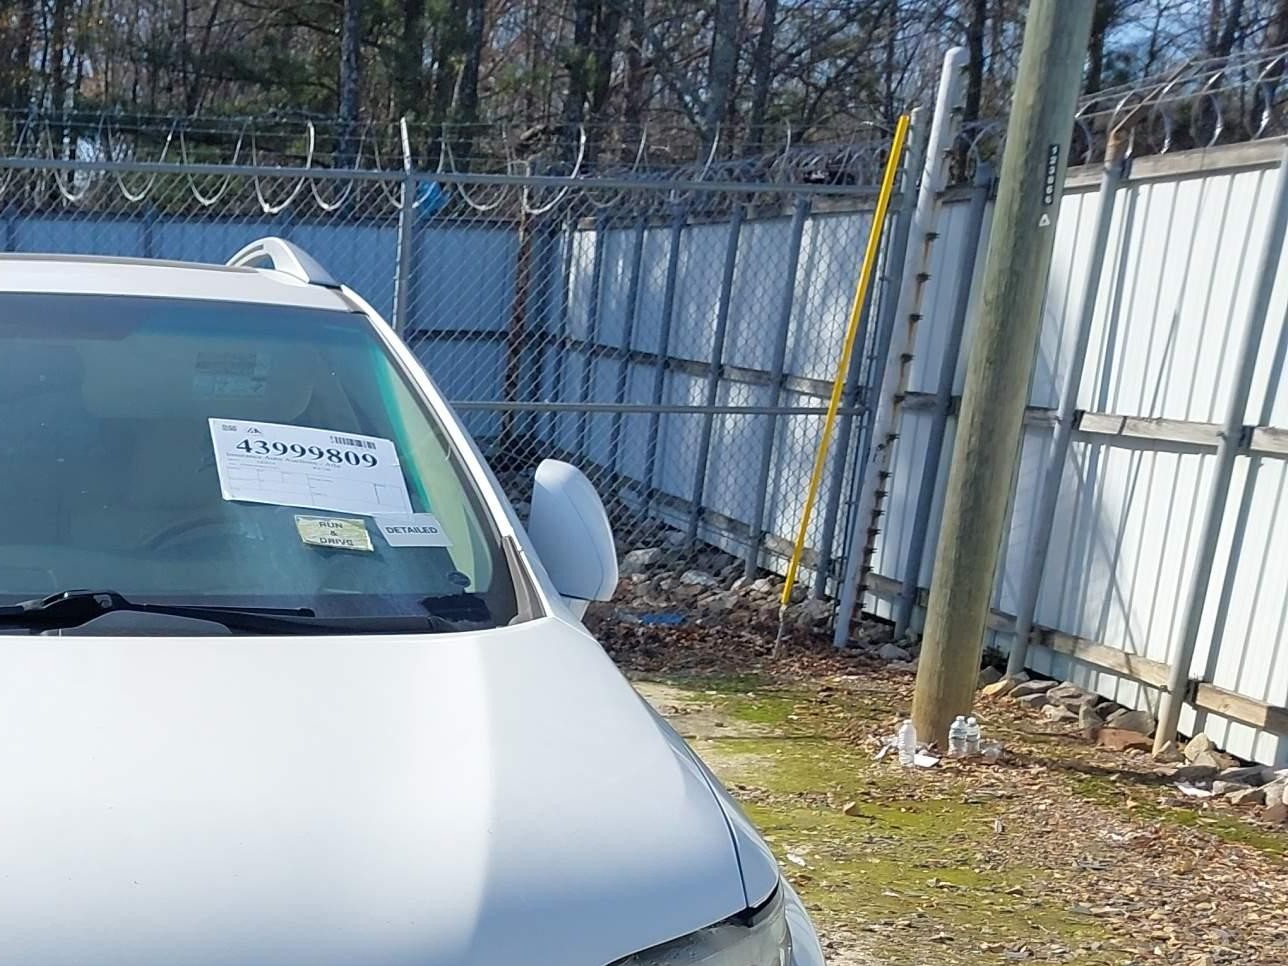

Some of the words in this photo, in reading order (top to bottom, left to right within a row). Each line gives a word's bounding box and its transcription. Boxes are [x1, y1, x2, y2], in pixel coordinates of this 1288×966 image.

[236, 438, 378, 468] 43999809
[319, 521, 343, 529] RUN
[385, 526, 438, 534] DETAILED
